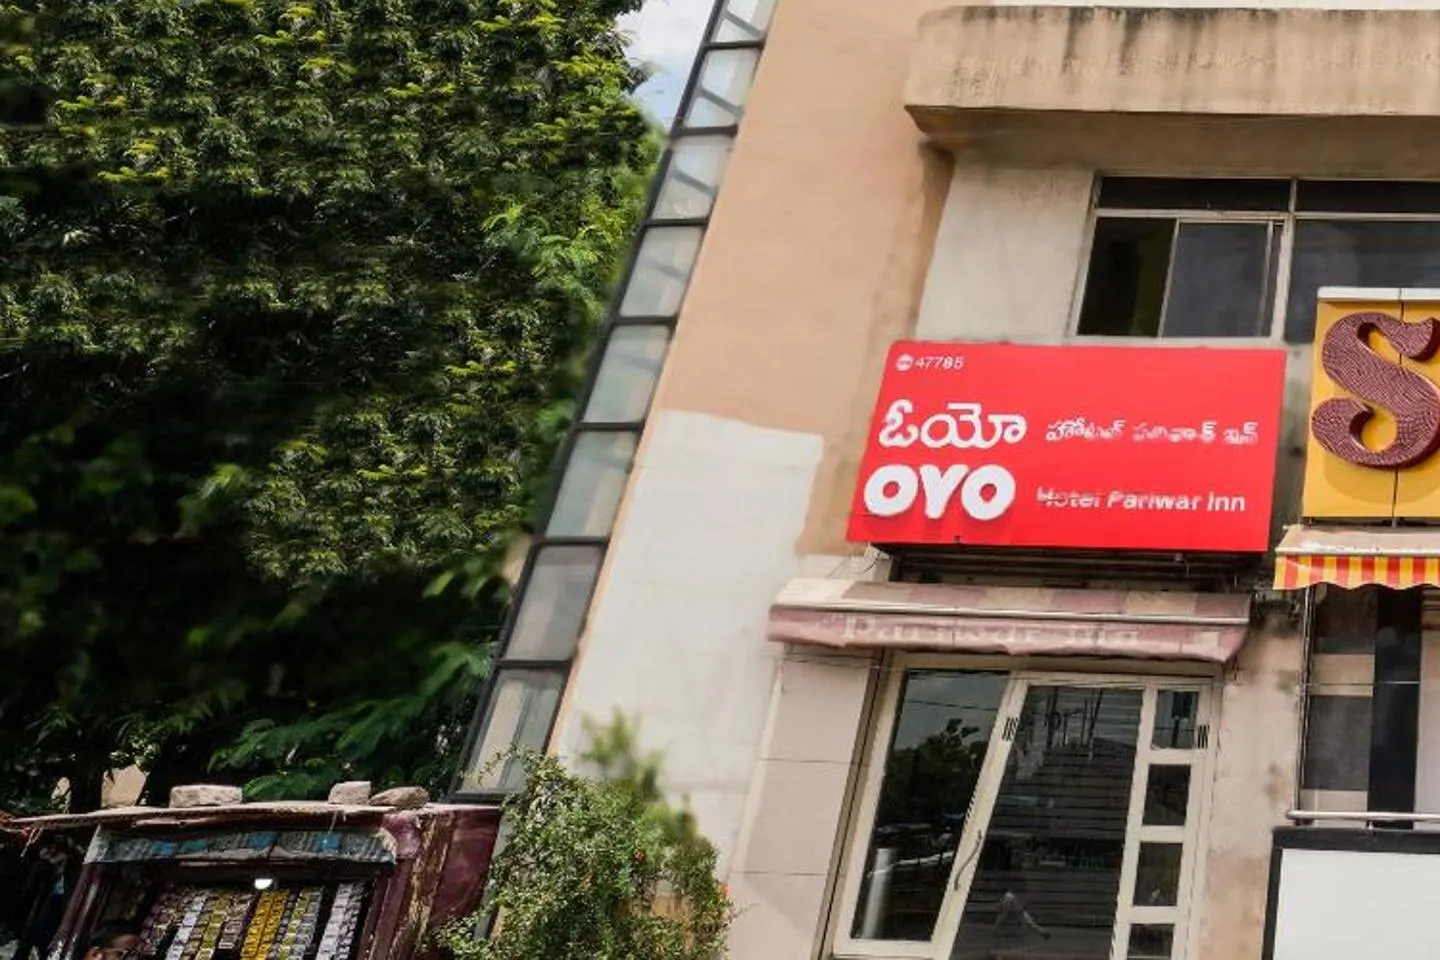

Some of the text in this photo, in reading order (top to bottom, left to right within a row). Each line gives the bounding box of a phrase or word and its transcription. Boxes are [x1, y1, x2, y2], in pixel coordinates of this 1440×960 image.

[878, 399, 1028, 449] ఓయో
[863, 464, 1016, 522] OYO
[1036, 487, 1101, 509] Hotel
[1207, 491, 1245, 512] Inn
